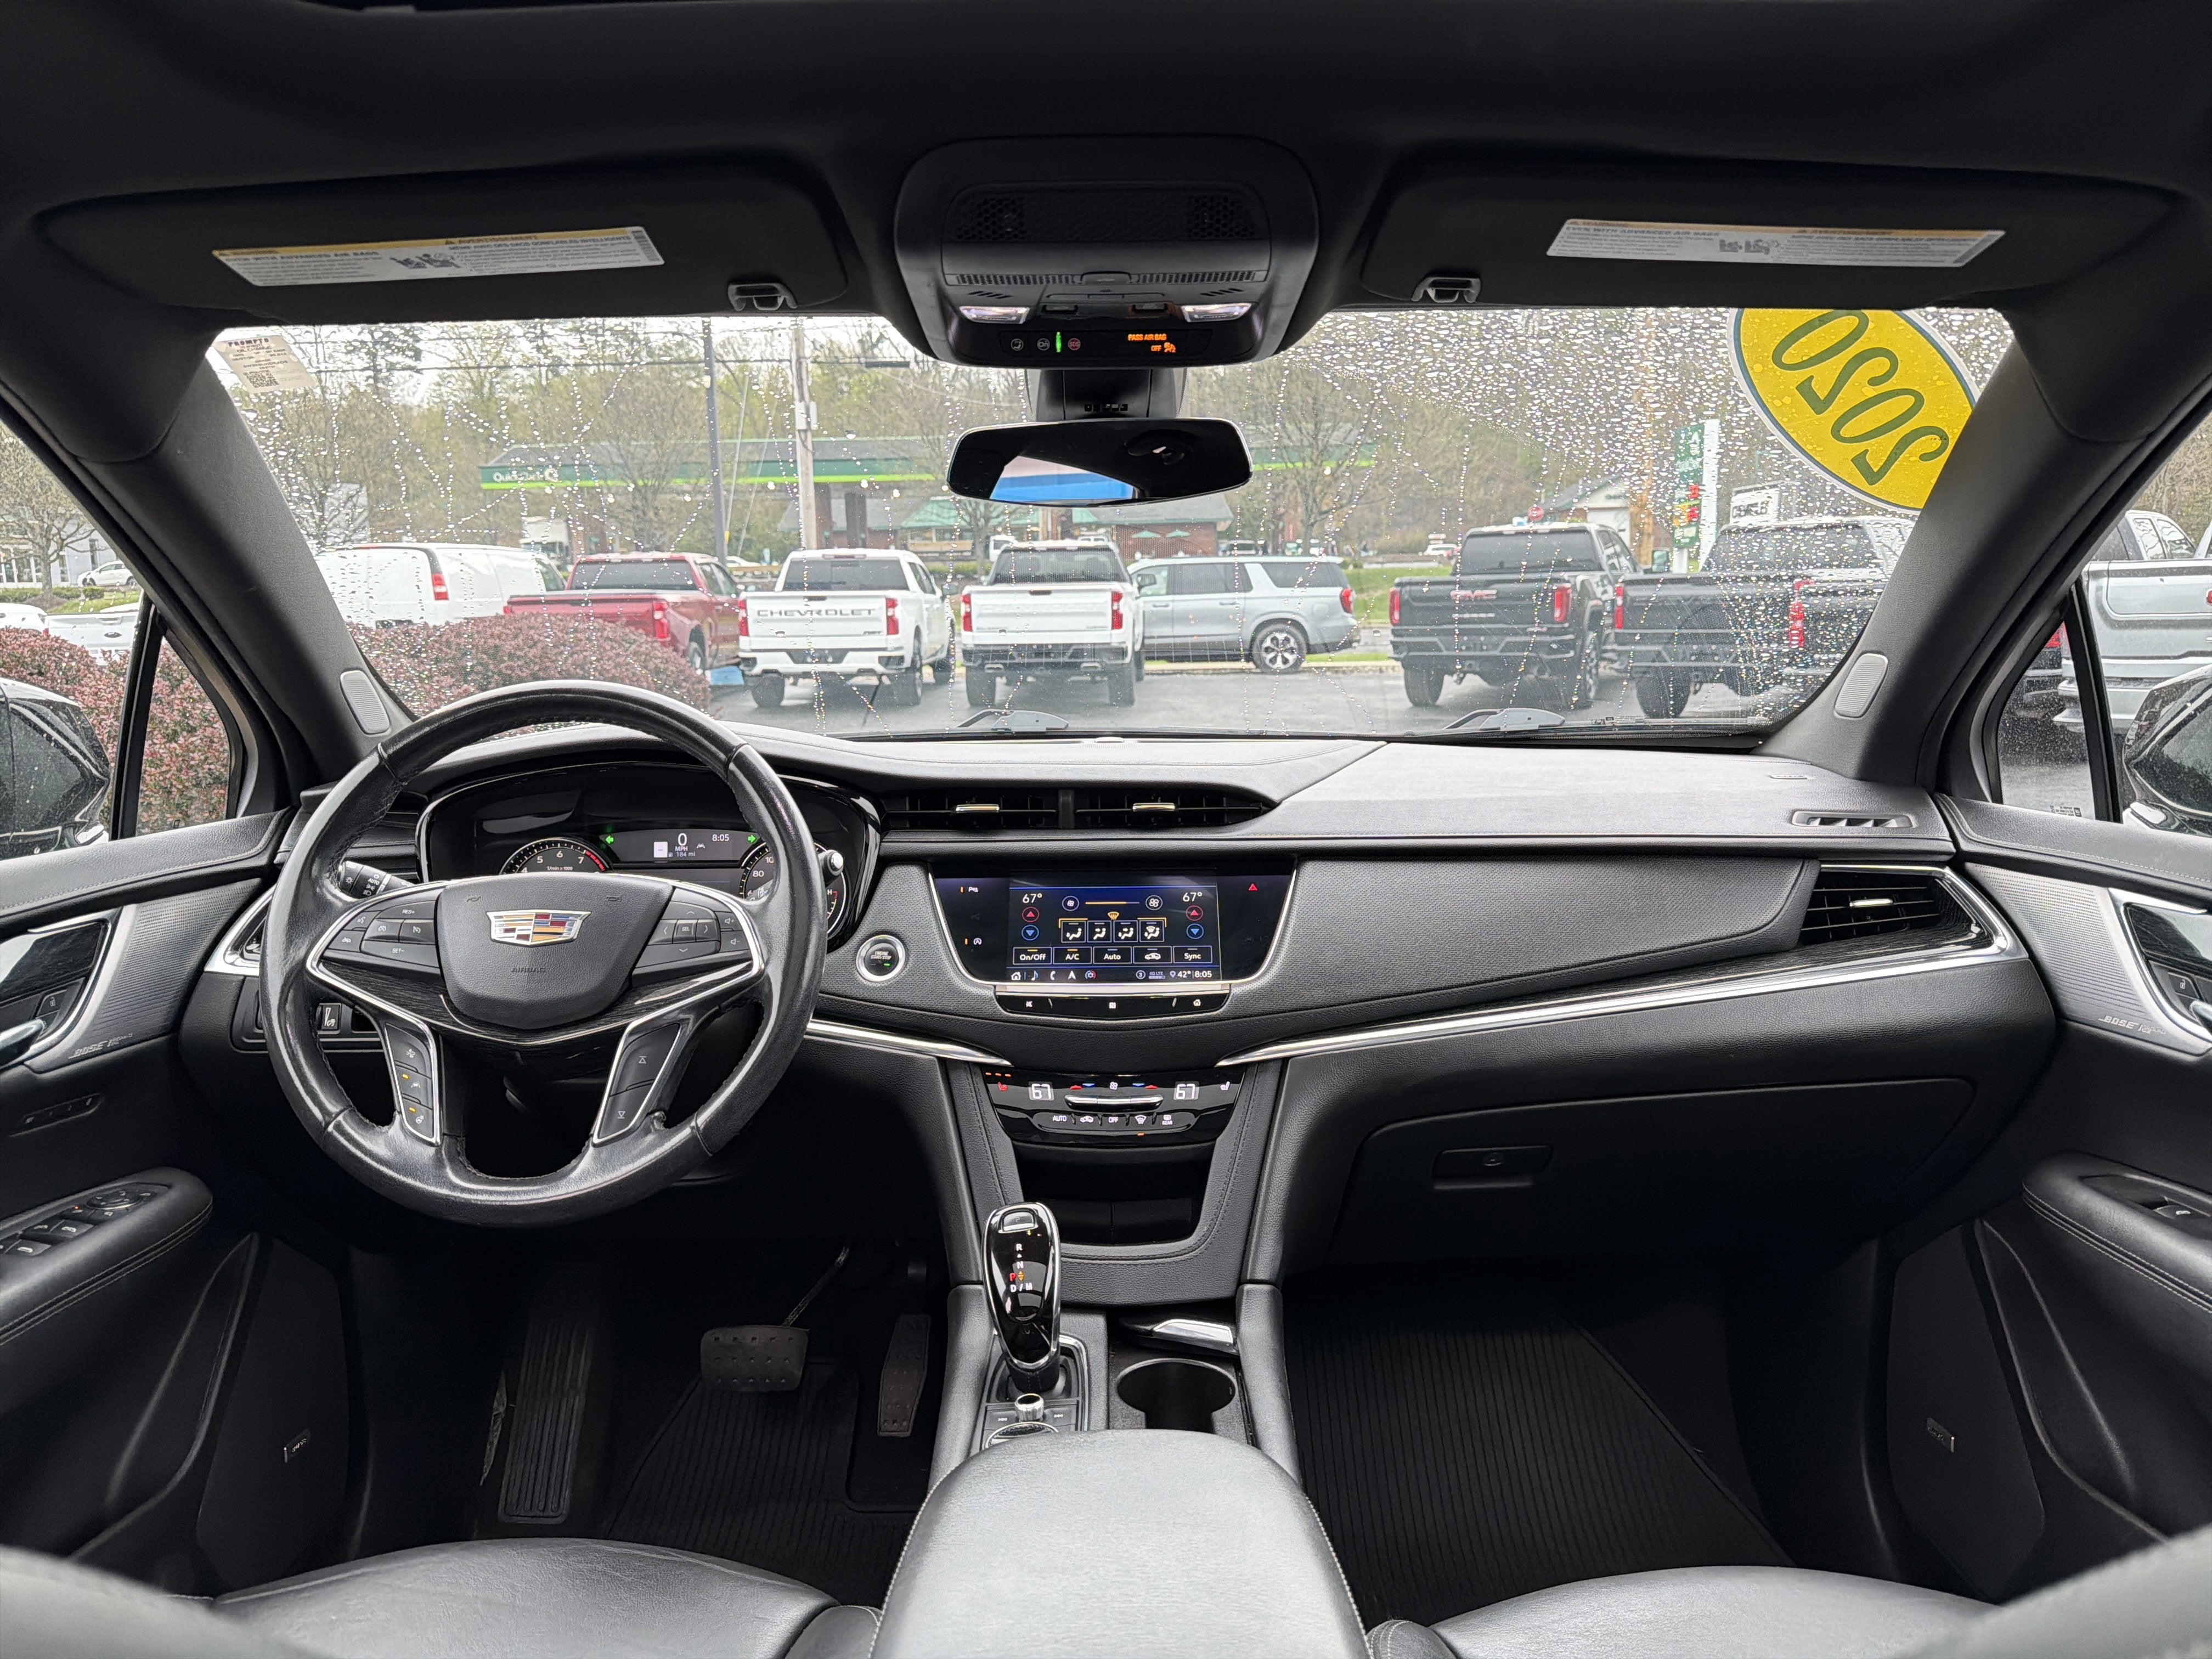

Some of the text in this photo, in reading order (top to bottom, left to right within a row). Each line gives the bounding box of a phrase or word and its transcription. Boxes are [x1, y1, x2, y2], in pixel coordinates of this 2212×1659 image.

[228, 338, 269, 347] PROMPTO
[1450, 589, 1498, 600] GMC
[757, 608, 876, 617] CHEVROLET
[678, 833, 730, 846] 0 8:05
[1022, 891, 1203, 904] 67° 67°
[1184, 953, 1201, 961] Sync
[2098, 1015, 2139, 1029] BOSE
[68, 1040, 109, 1059] BOSE
[1031, 1084, 1195, 1101] 67 67
[1016, 1243, 1023, 1251] R
[1017, 1261, 1024, 1269] N
[1009, 1272, 1017, 1282] P
